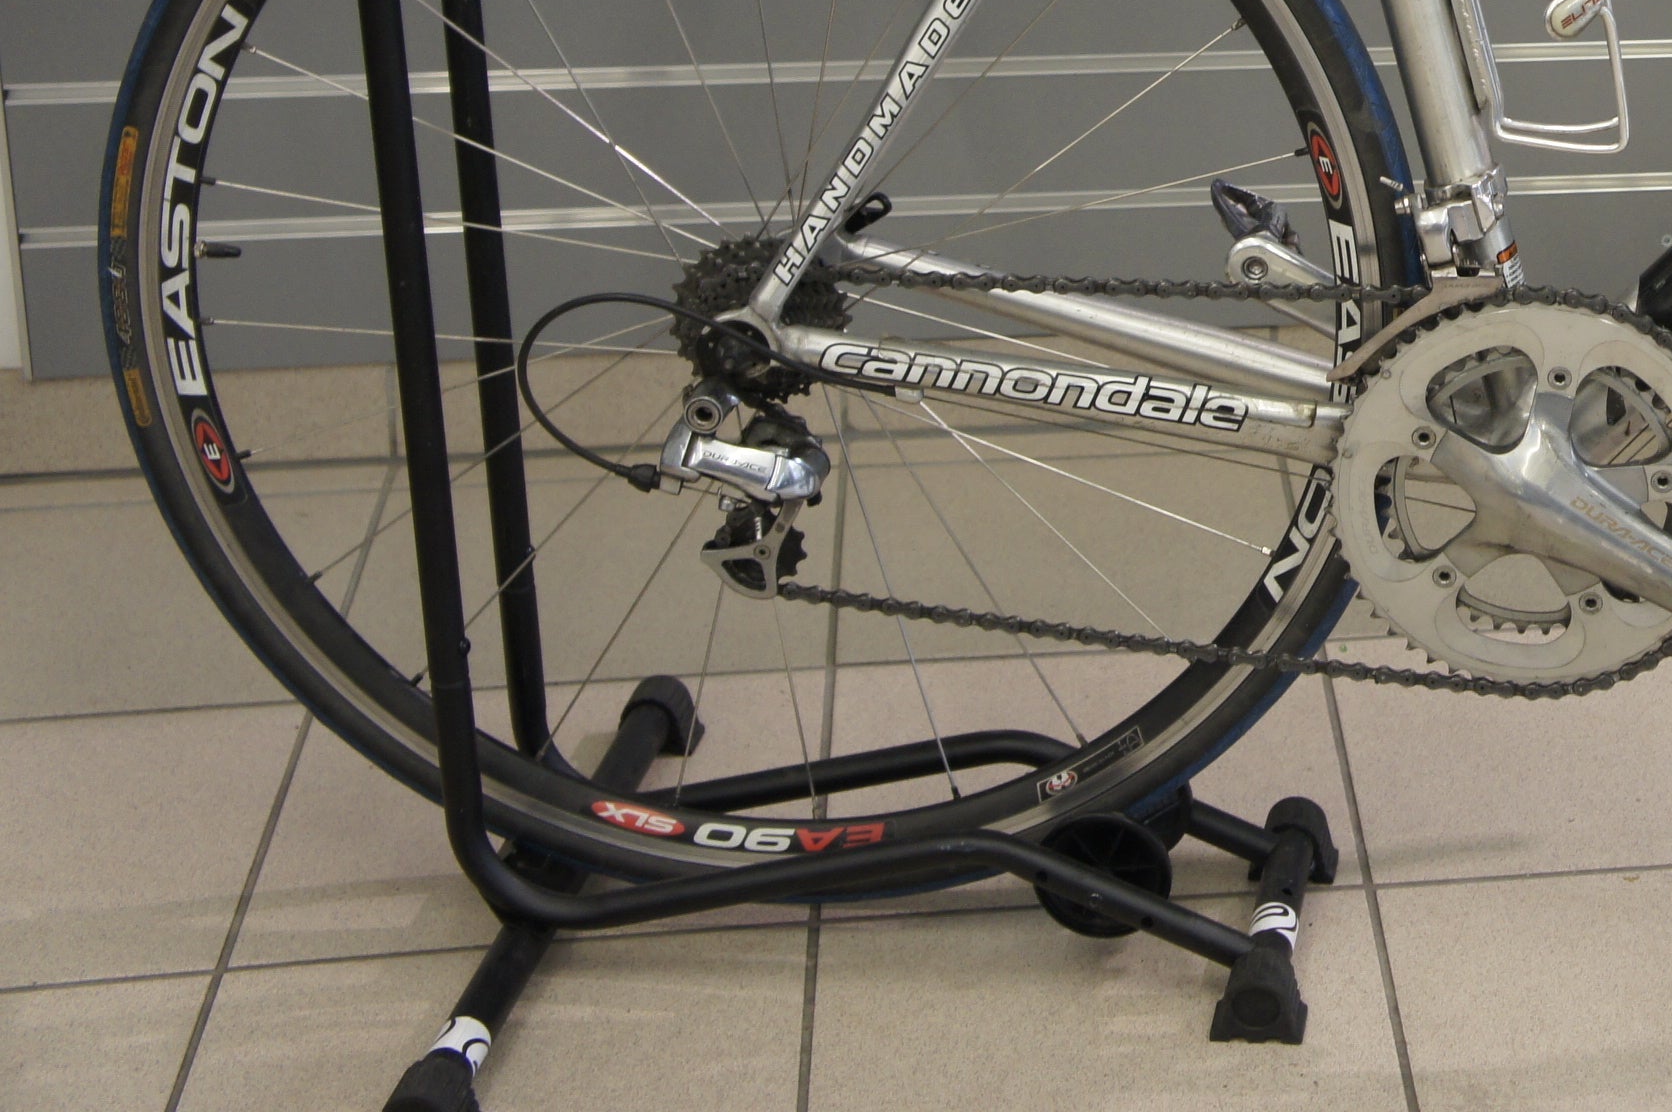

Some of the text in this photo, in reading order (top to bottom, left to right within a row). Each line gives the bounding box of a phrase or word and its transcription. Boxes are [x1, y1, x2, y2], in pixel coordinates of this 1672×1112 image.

[161, 4, 249, 396] EASTON
[817, 341, 1250, 432] cannondale
[603, 800, 677, 834] SLX
[694, 819, 886, 852] EA90
